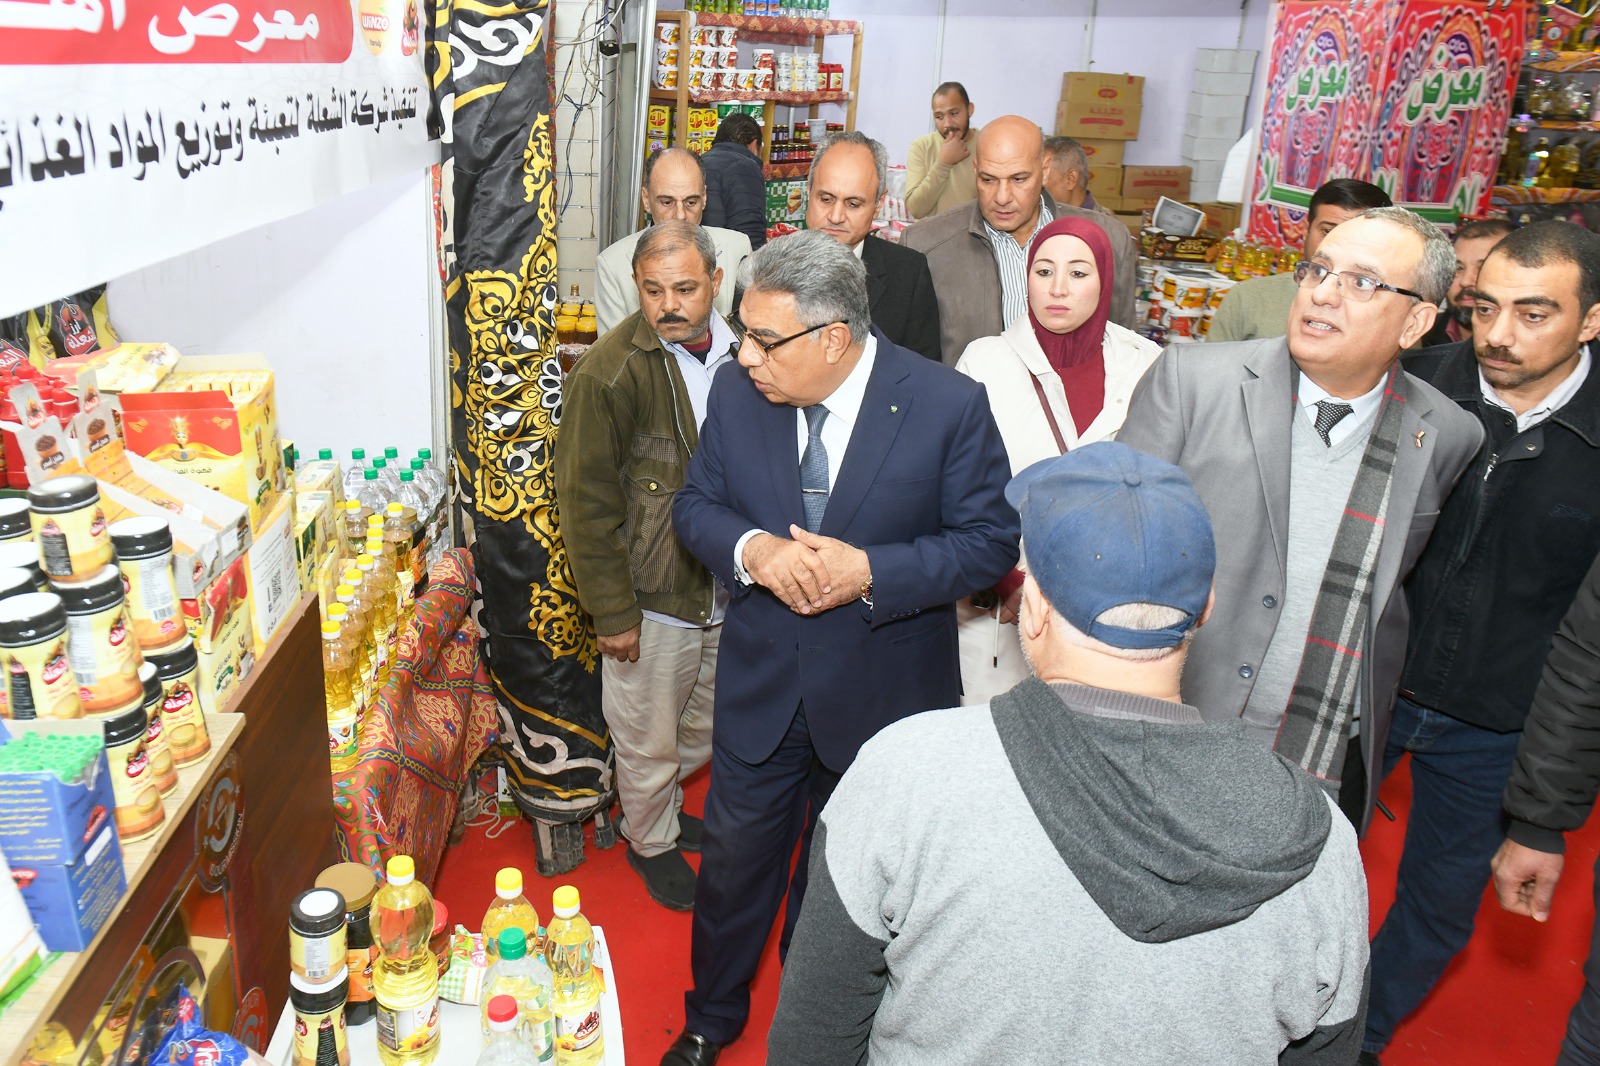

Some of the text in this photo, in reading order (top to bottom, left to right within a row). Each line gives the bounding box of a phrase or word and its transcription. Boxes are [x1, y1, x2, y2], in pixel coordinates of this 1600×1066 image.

[1285, 44, 1349, 112] معرض
[1406, 47, 1483, 121] معرض
[0, 86, 418, 188] تنفيذ شركة الشعلة لتعبئة وتوزيع المواد الغذائ
[163, 691, 193, 709] الشعلة
